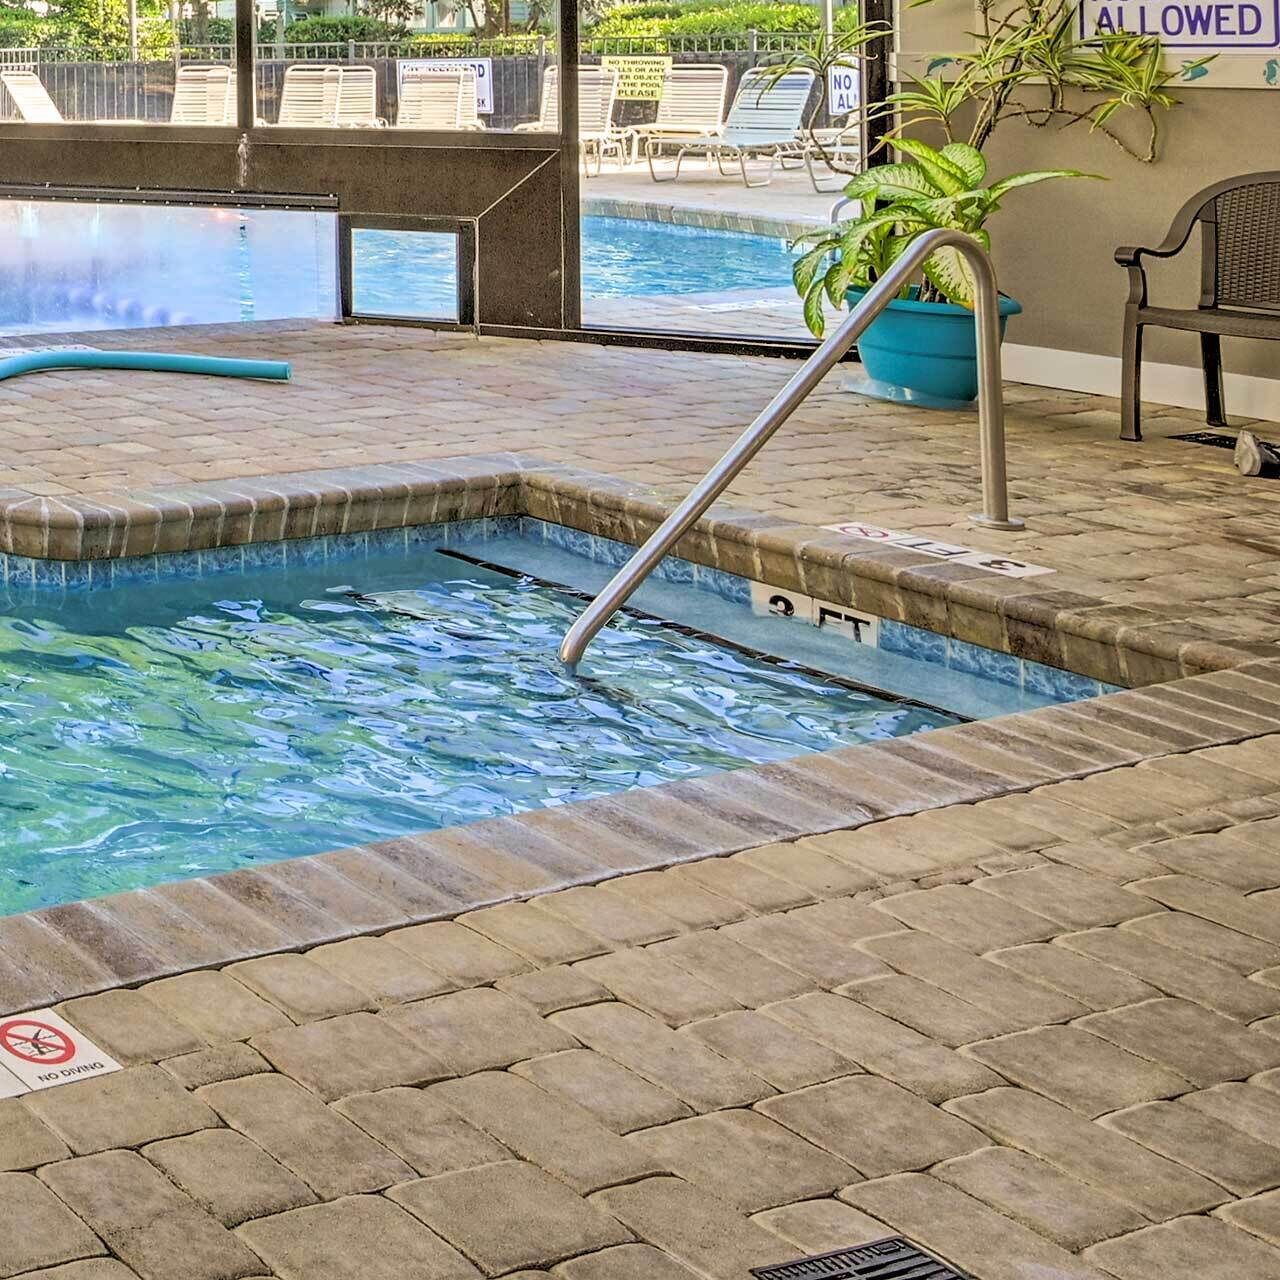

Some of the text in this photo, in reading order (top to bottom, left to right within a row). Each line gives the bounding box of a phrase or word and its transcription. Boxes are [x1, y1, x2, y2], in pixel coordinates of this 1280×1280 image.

[1094, 4, 1262, 36] ALLOWED
[833, 74, 852, 90] NO
[618, 89, 656, 97] PLEASE
[37, 1061, 105, 1082] NO DIVING
